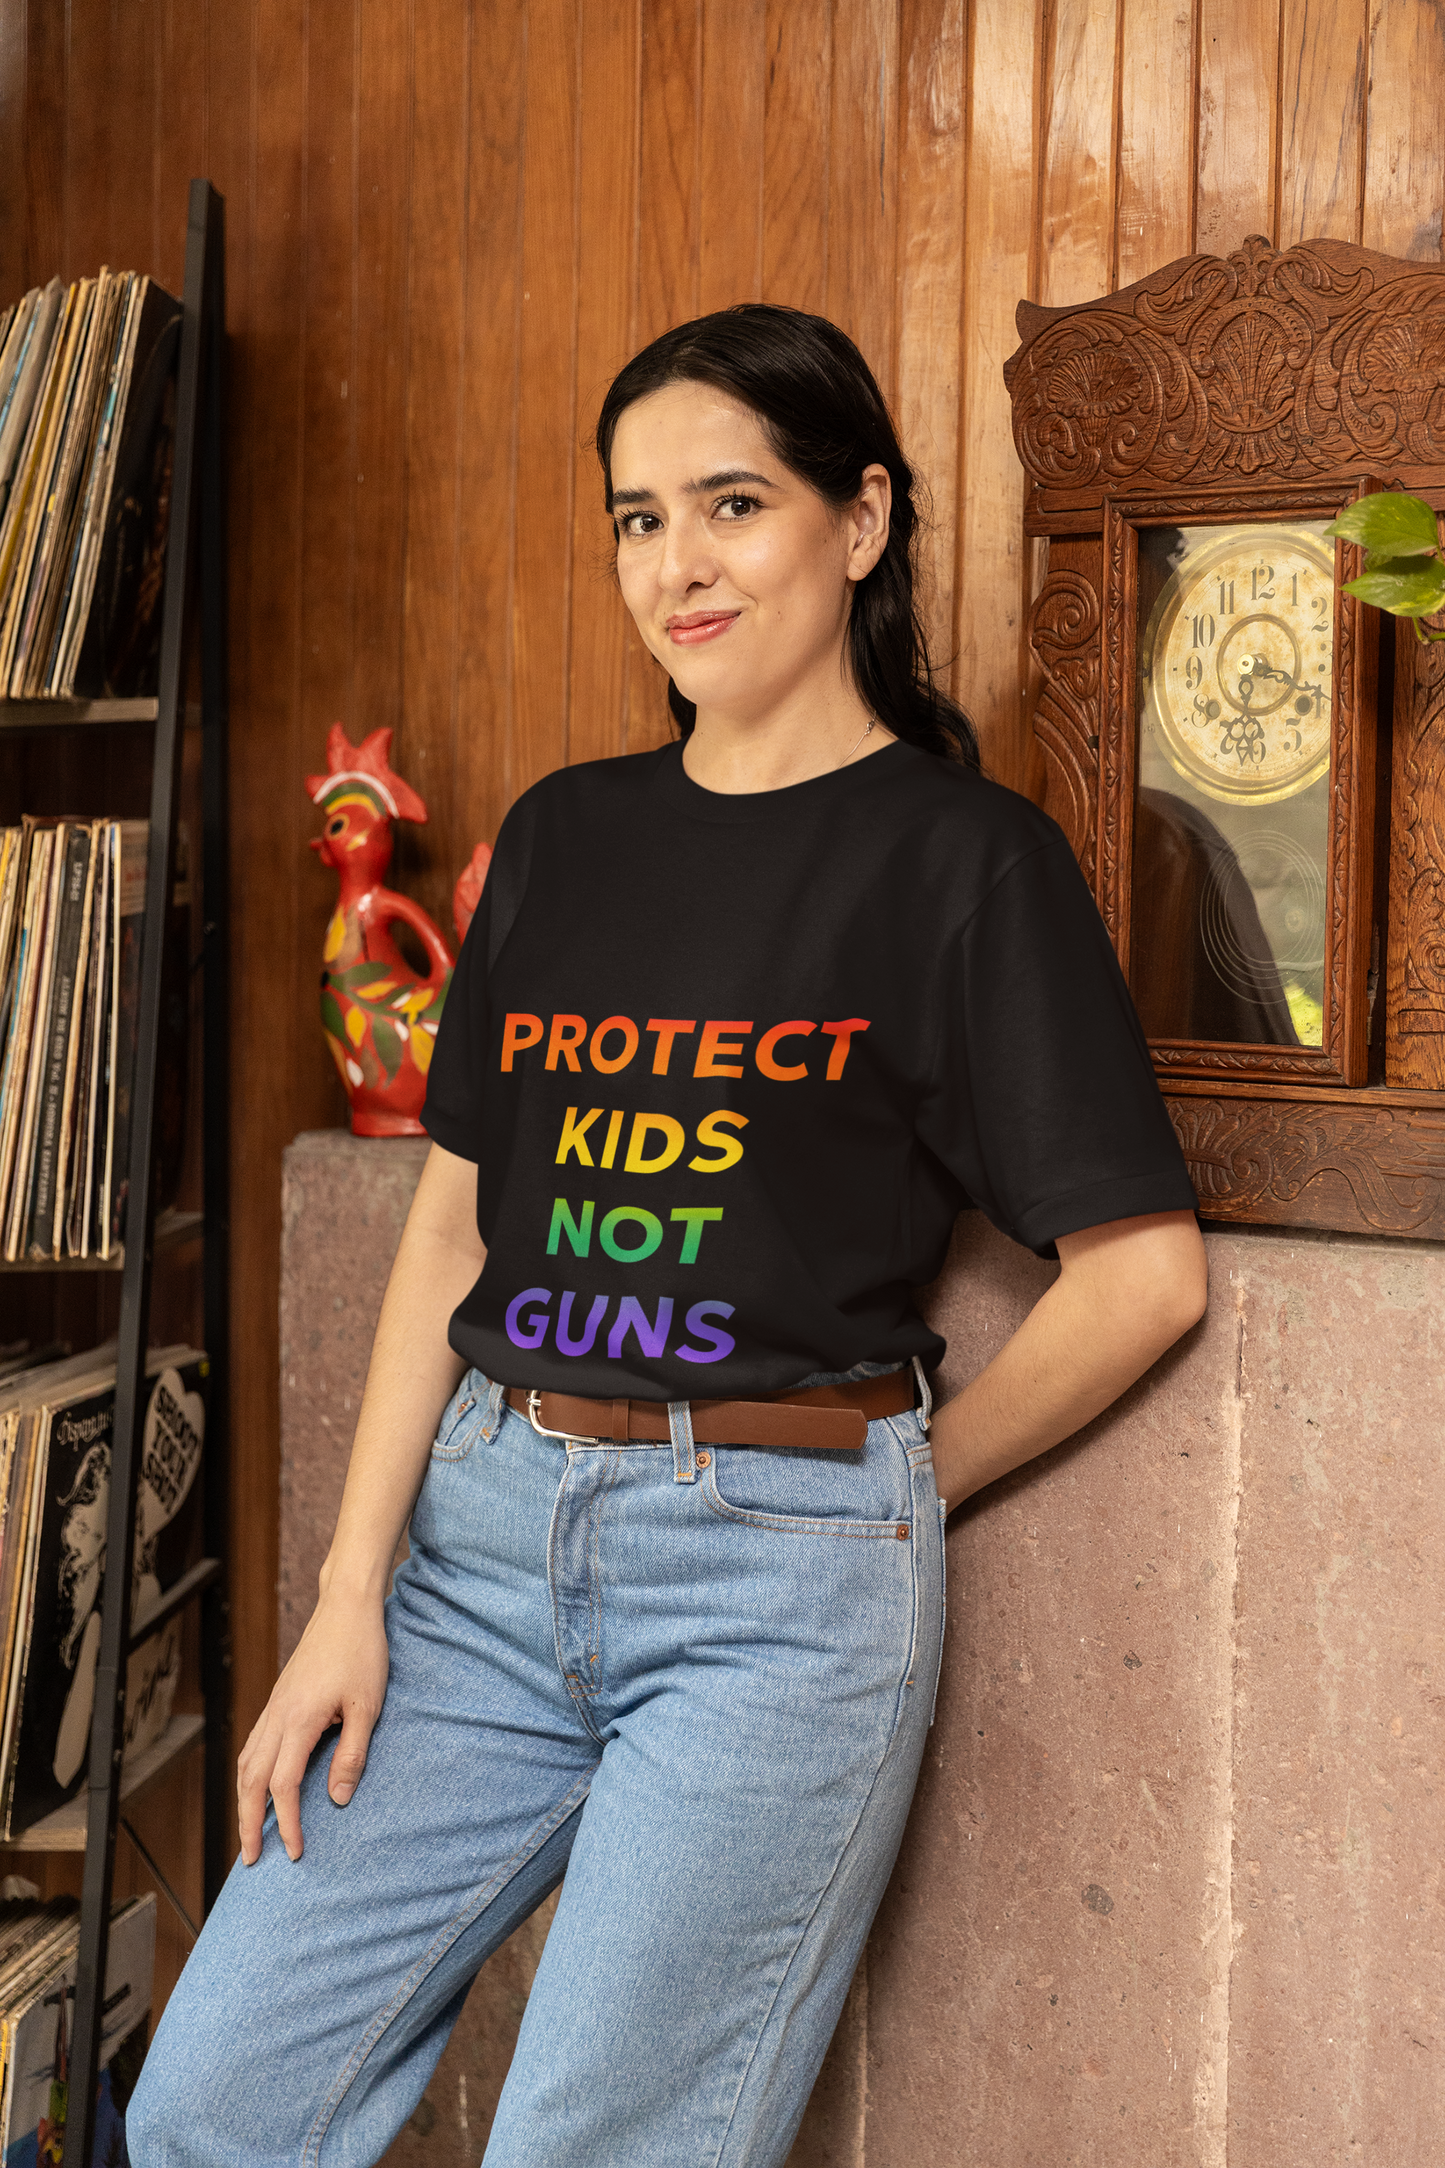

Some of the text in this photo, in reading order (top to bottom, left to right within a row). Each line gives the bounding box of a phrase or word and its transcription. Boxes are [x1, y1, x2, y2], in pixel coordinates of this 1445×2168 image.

[1219, 580, 1235, 615] 11
[1250, 565, 1276, 601] 12
[1291, 572, 1299, 607] 1
[1192, 614, 1216, 649] 10
[1311, 597, 1329, 632] 2
[1185, 655, 1203, 691] 9
[1191, 693, 1211, 728] 8
[1283, 718, 1302, 752] 5
[500, 1013, 872, 1081] PROTECT
[555, 1106, 751, 1174] KIDS
[546, 1197, 724, 1264] NOT
[505, 1287, 736, 1364] GUNS
